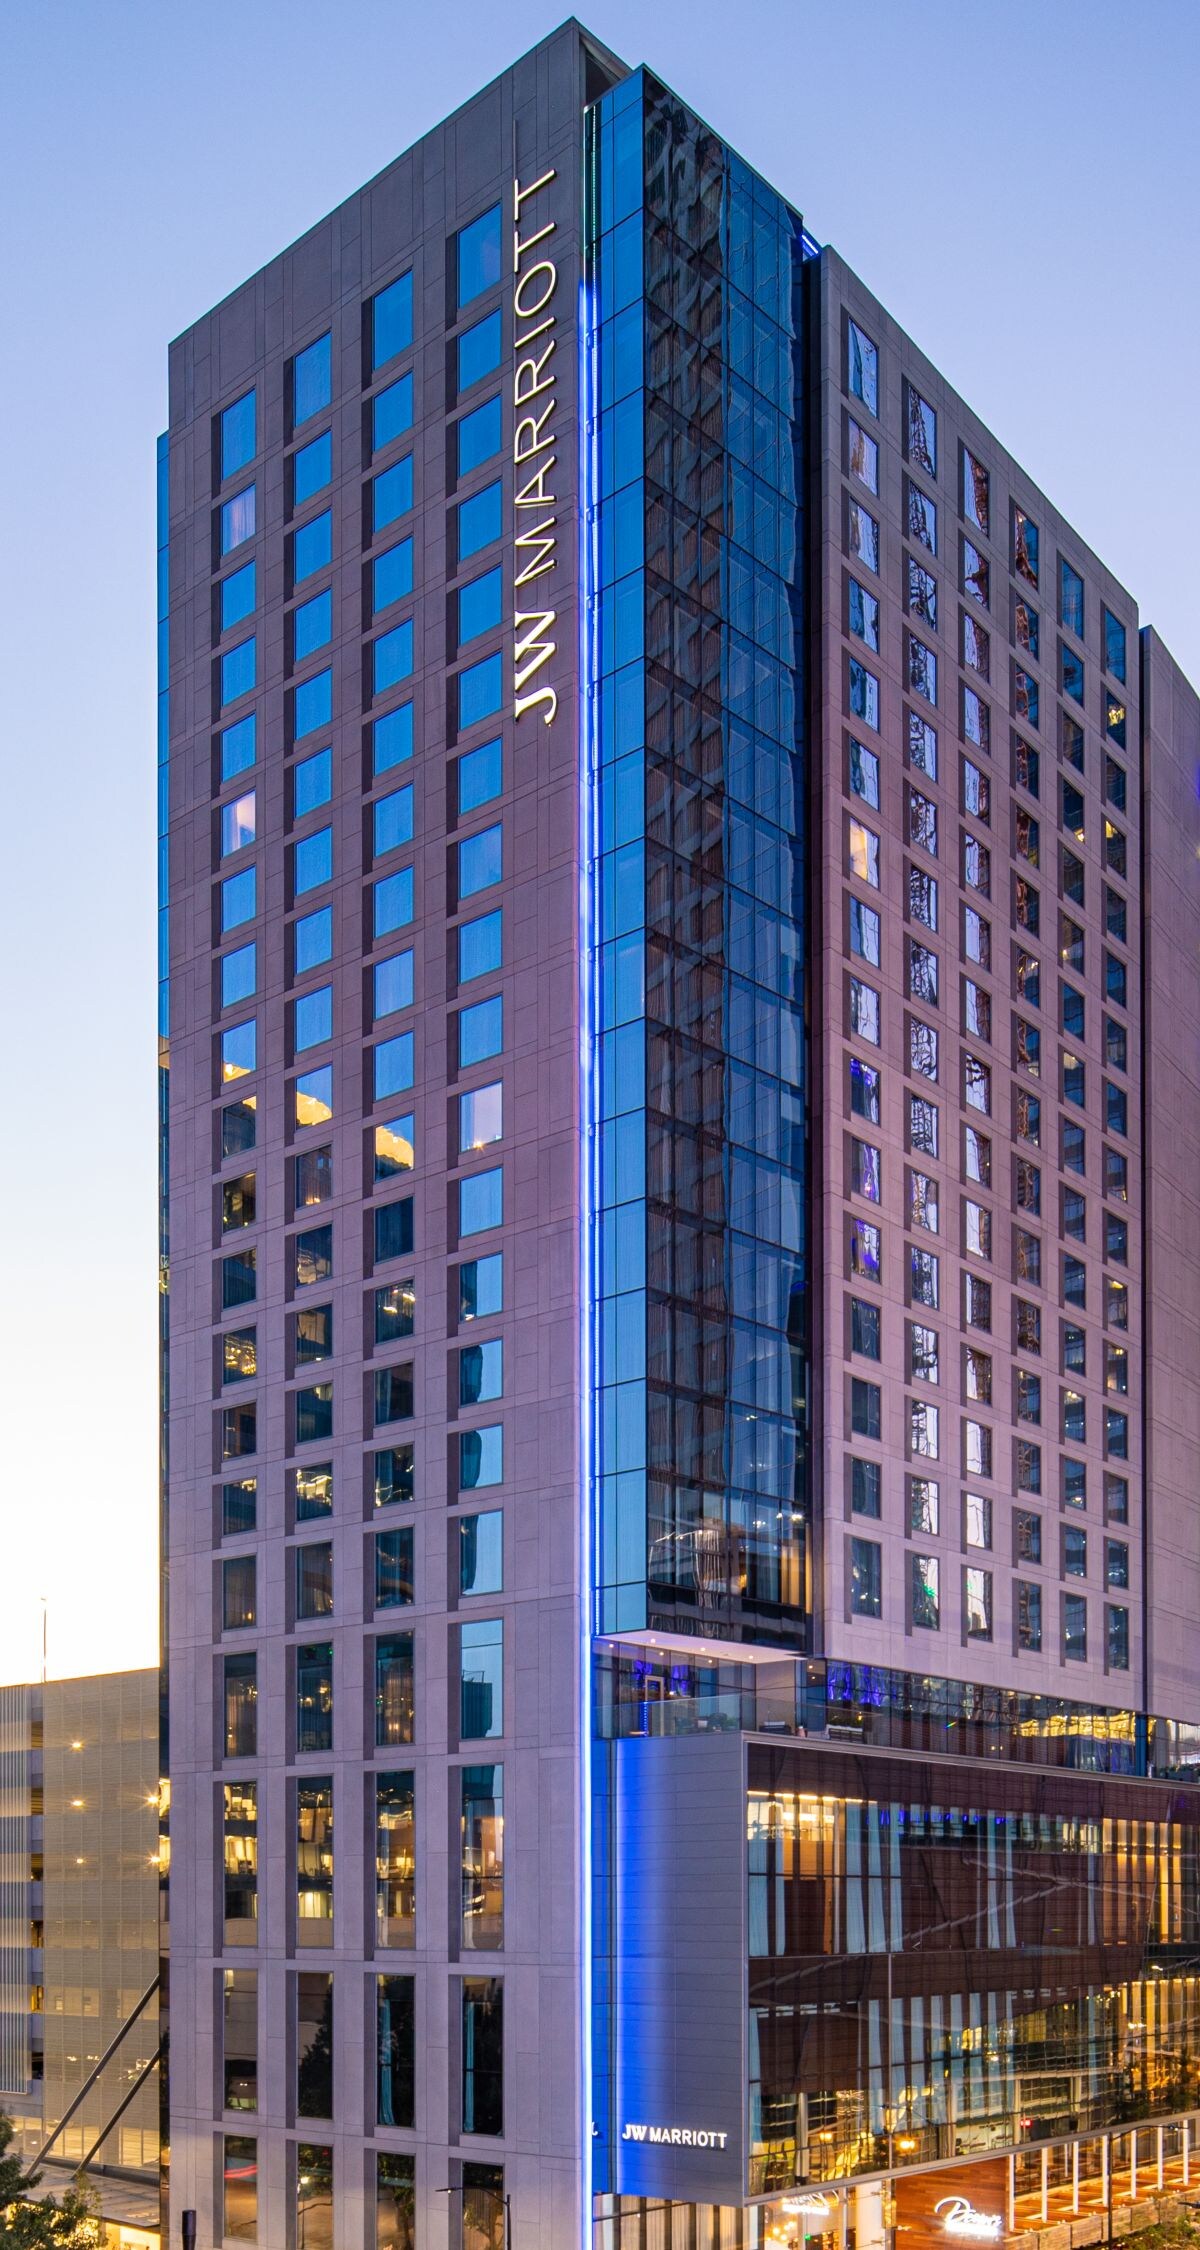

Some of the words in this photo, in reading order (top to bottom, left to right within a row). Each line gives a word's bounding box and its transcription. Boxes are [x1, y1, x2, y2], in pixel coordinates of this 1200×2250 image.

[513, 168, 558, 587] MARRIOTT
[513, 610, 558, 726] JW
[622, 2123, 648, 2141] JW
[649, 2126, 728, 2149] MARRIOTT
